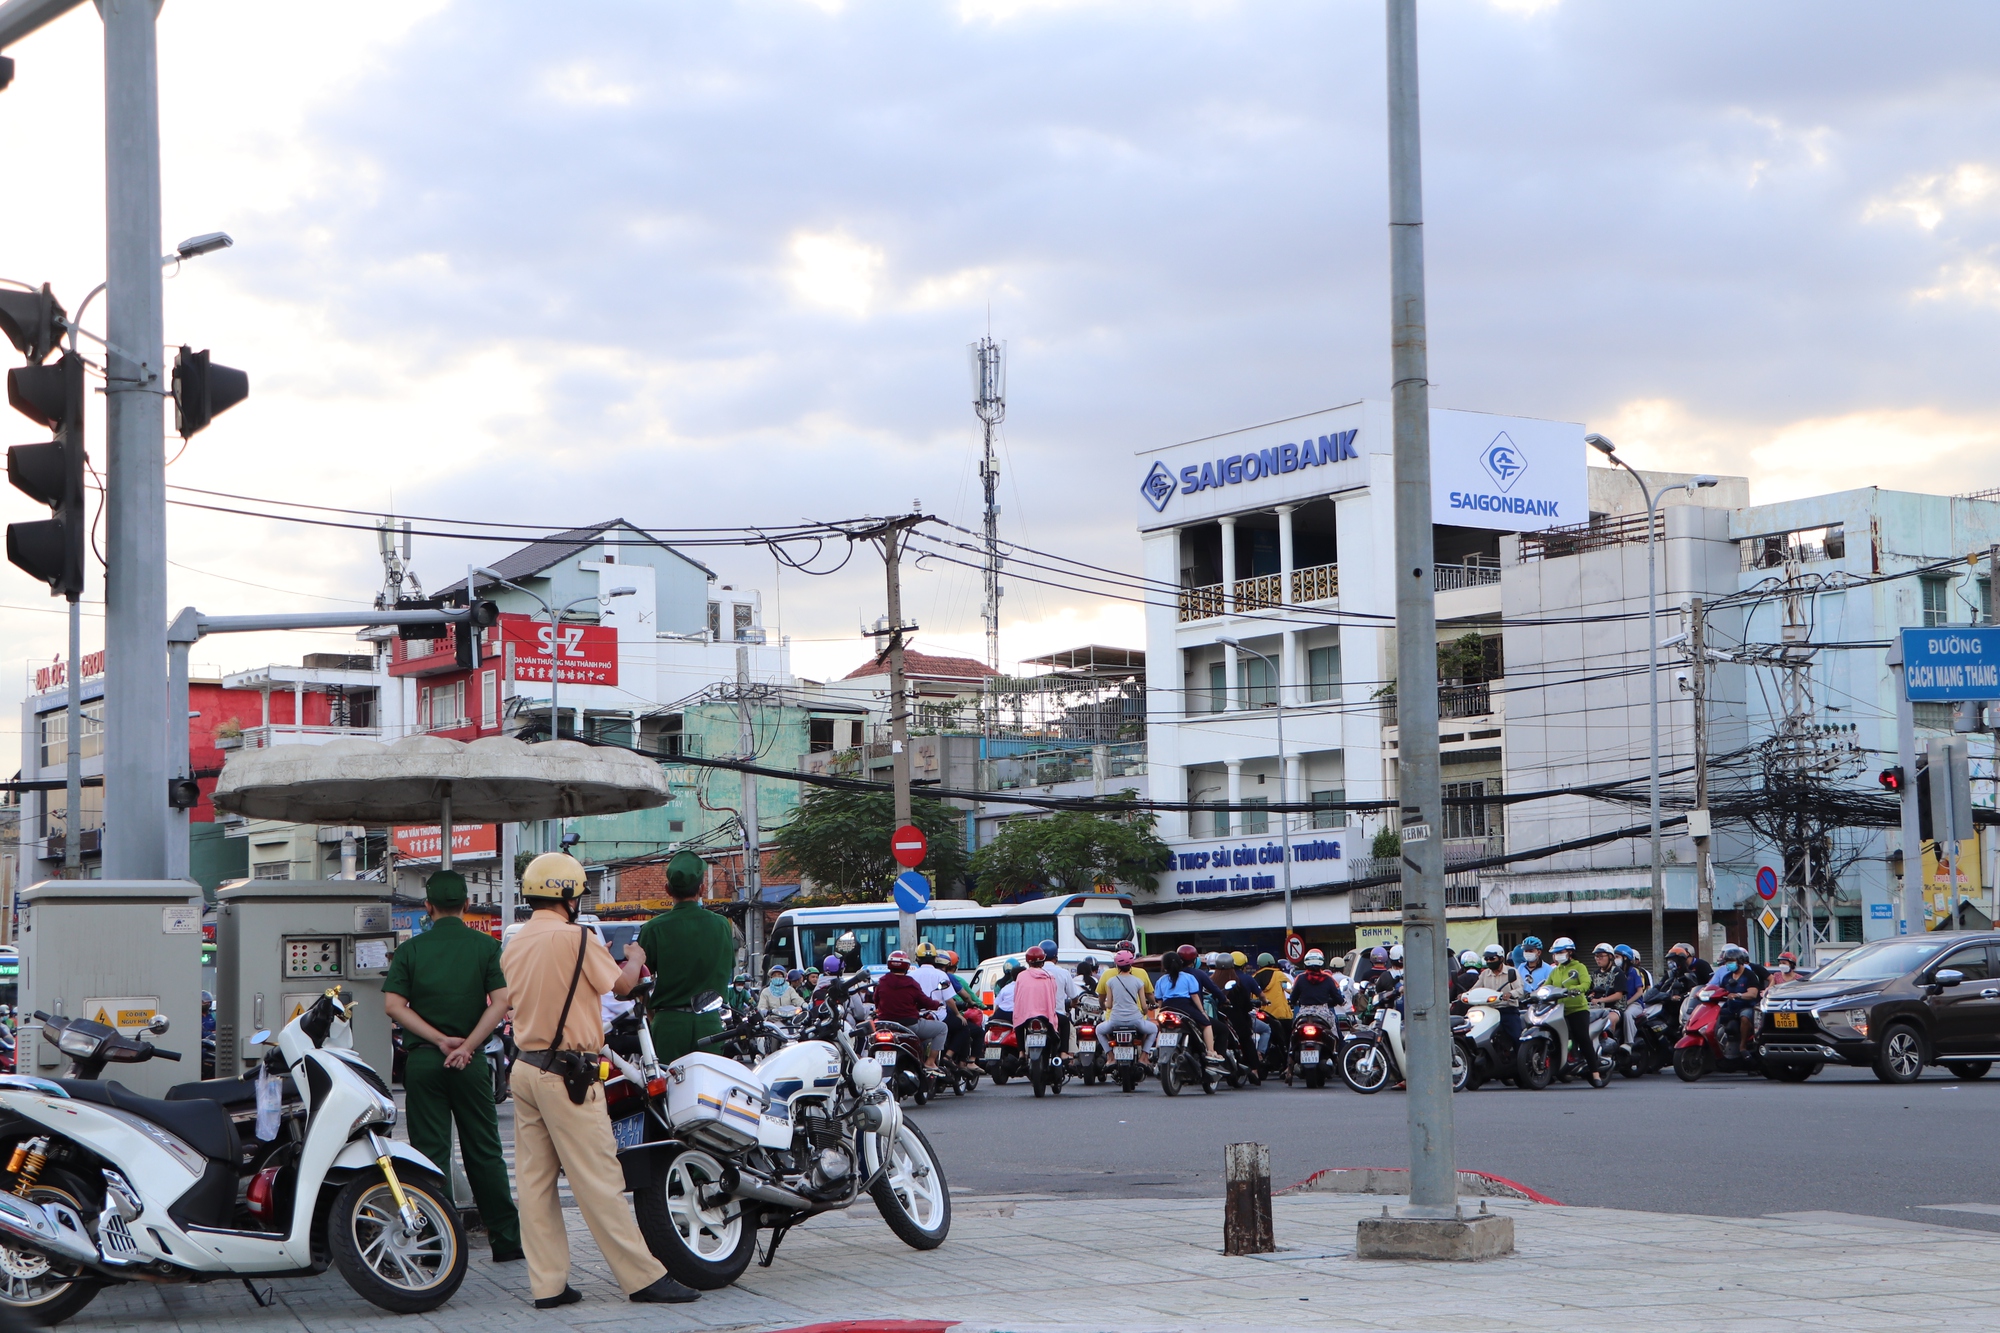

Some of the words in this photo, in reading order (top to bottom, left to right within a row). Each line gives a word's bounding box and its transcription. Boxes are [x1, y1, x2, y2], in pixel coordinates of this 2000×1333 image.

[1180, 428, 1358, 495] SAIGONBANK
[1449, 491, 1559, 517] SAIGONBANK
[1928, 635, 1982, 655] ĐƯỜNG
[36, 666, 51, 694] ĐỊA
[1908, 660, 1934, 688] CÁCH
[1935, 665, 1964, 693] MẠNG
[1965, 659, 1998, 687] THÁNG
[1178, 852, 1210, 871] TMCP
[1212, 845, 1231, 868] SÀI
[1233, 843, 1257, 867] GÒN
[1259, 841, 1291, 864] CÔNG
[545, 879, 576, 889] CSGT
[1177, 880, 1194, 895] CHI
[1195, 875, 1227, 894] NHÁNH
[1229, 873, 1250, 891] TÂN
[1252, 872, 1275, 890] BÌNH
[765, 1115, 790, 1127] POLICE
